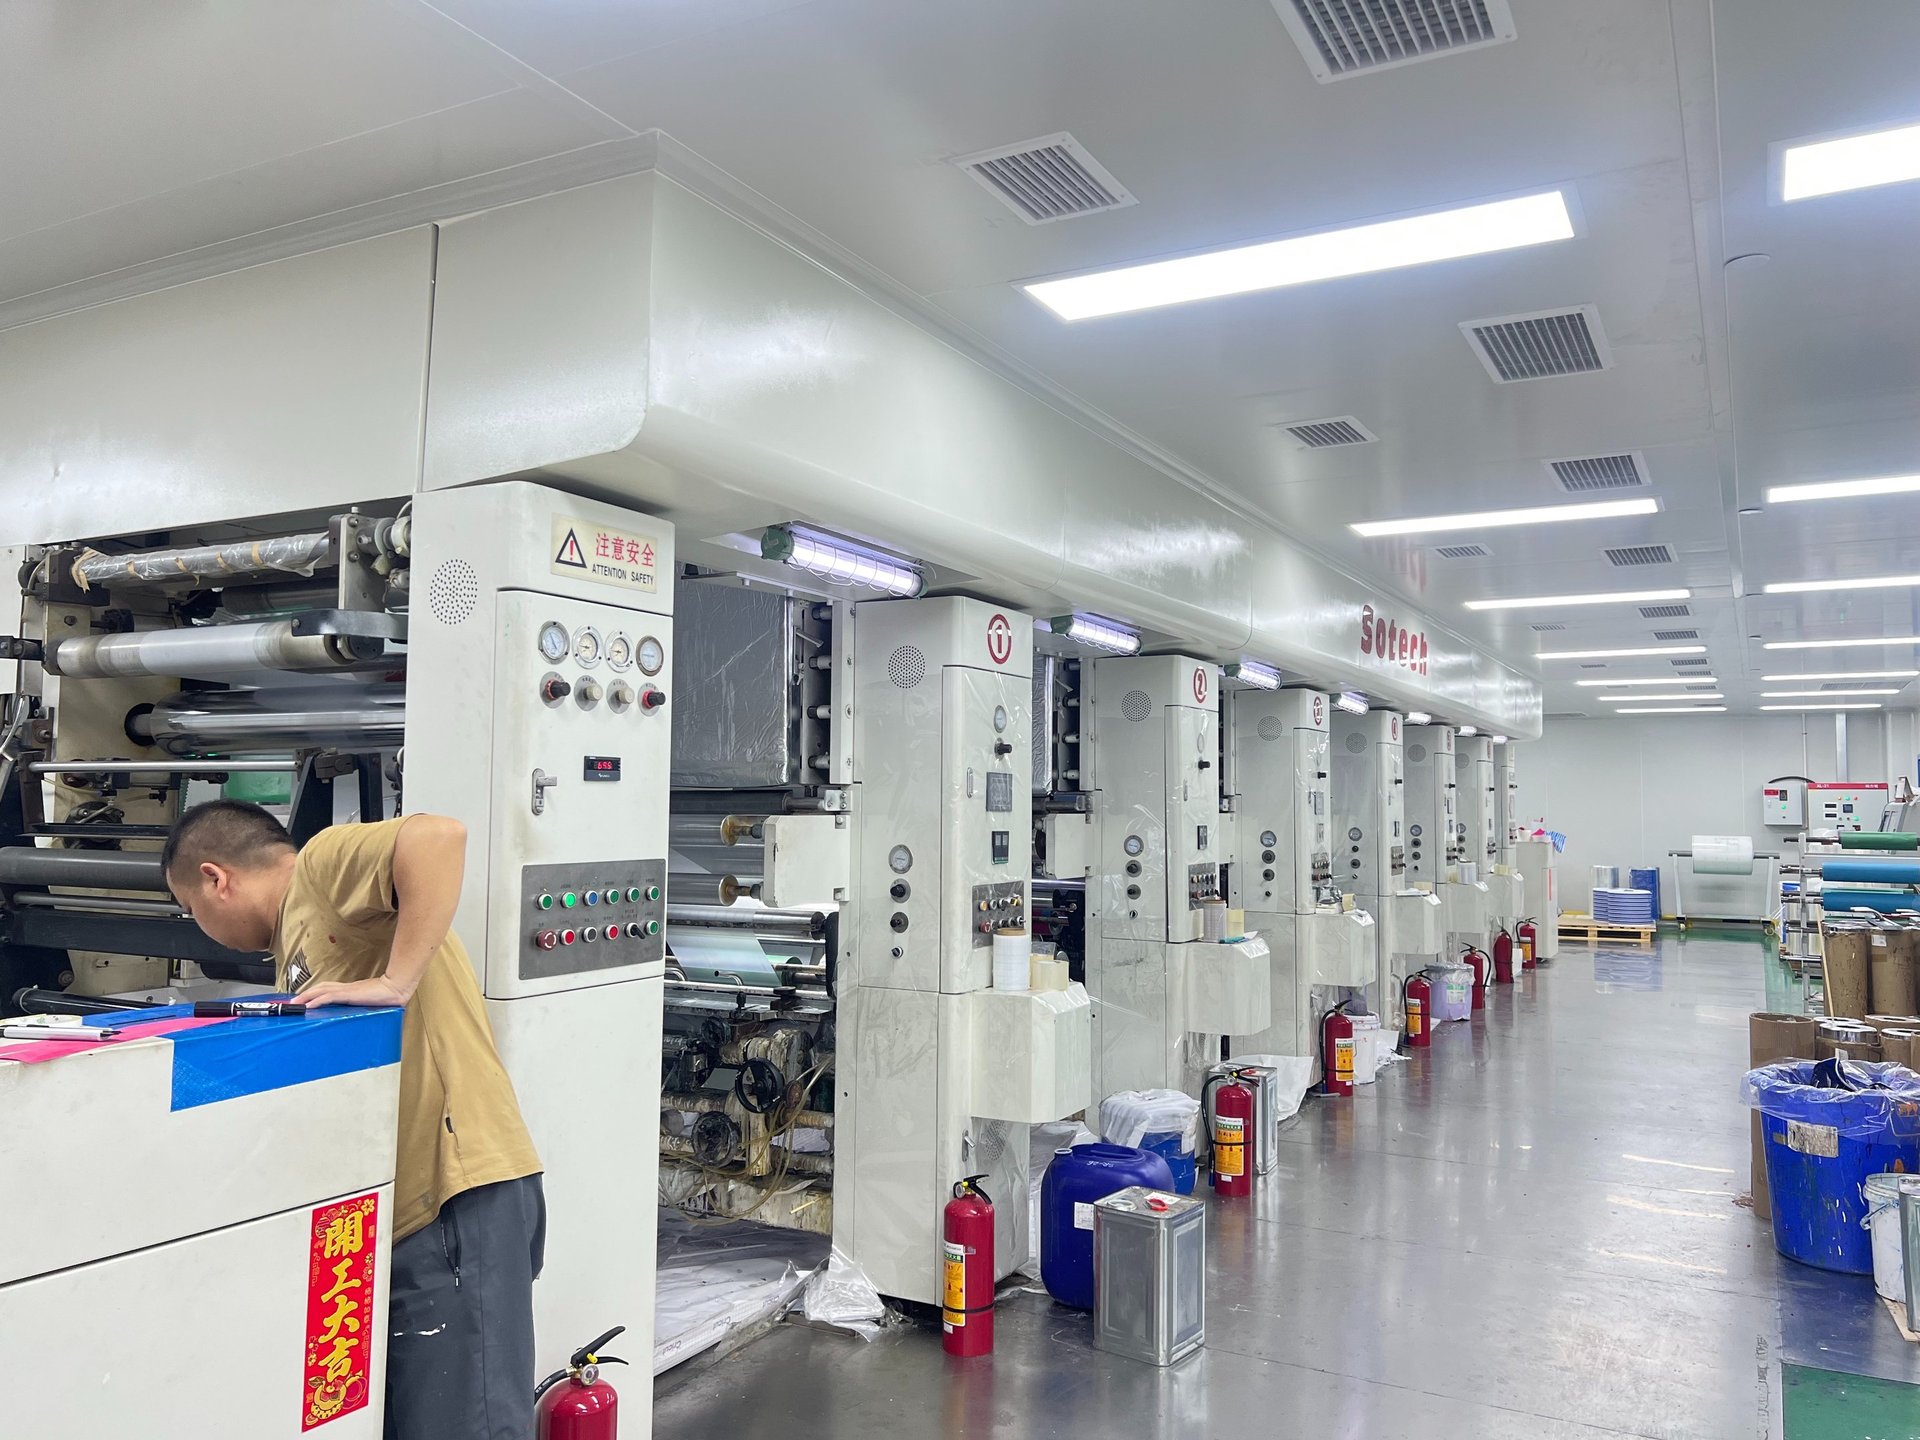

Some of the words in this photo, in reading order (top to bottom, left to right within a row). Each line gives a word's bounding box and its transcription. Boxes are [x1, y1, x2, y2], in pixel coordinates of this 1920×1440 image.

[592, 563, 627, 580] ATTENTION
[631, 571, 654, 584] SAFETY
[596, 532, 654, 567] 注意安全
[1360, 604, 1428, 676] Sotech
[317, 1210, 365, 1382] 開工大吉
